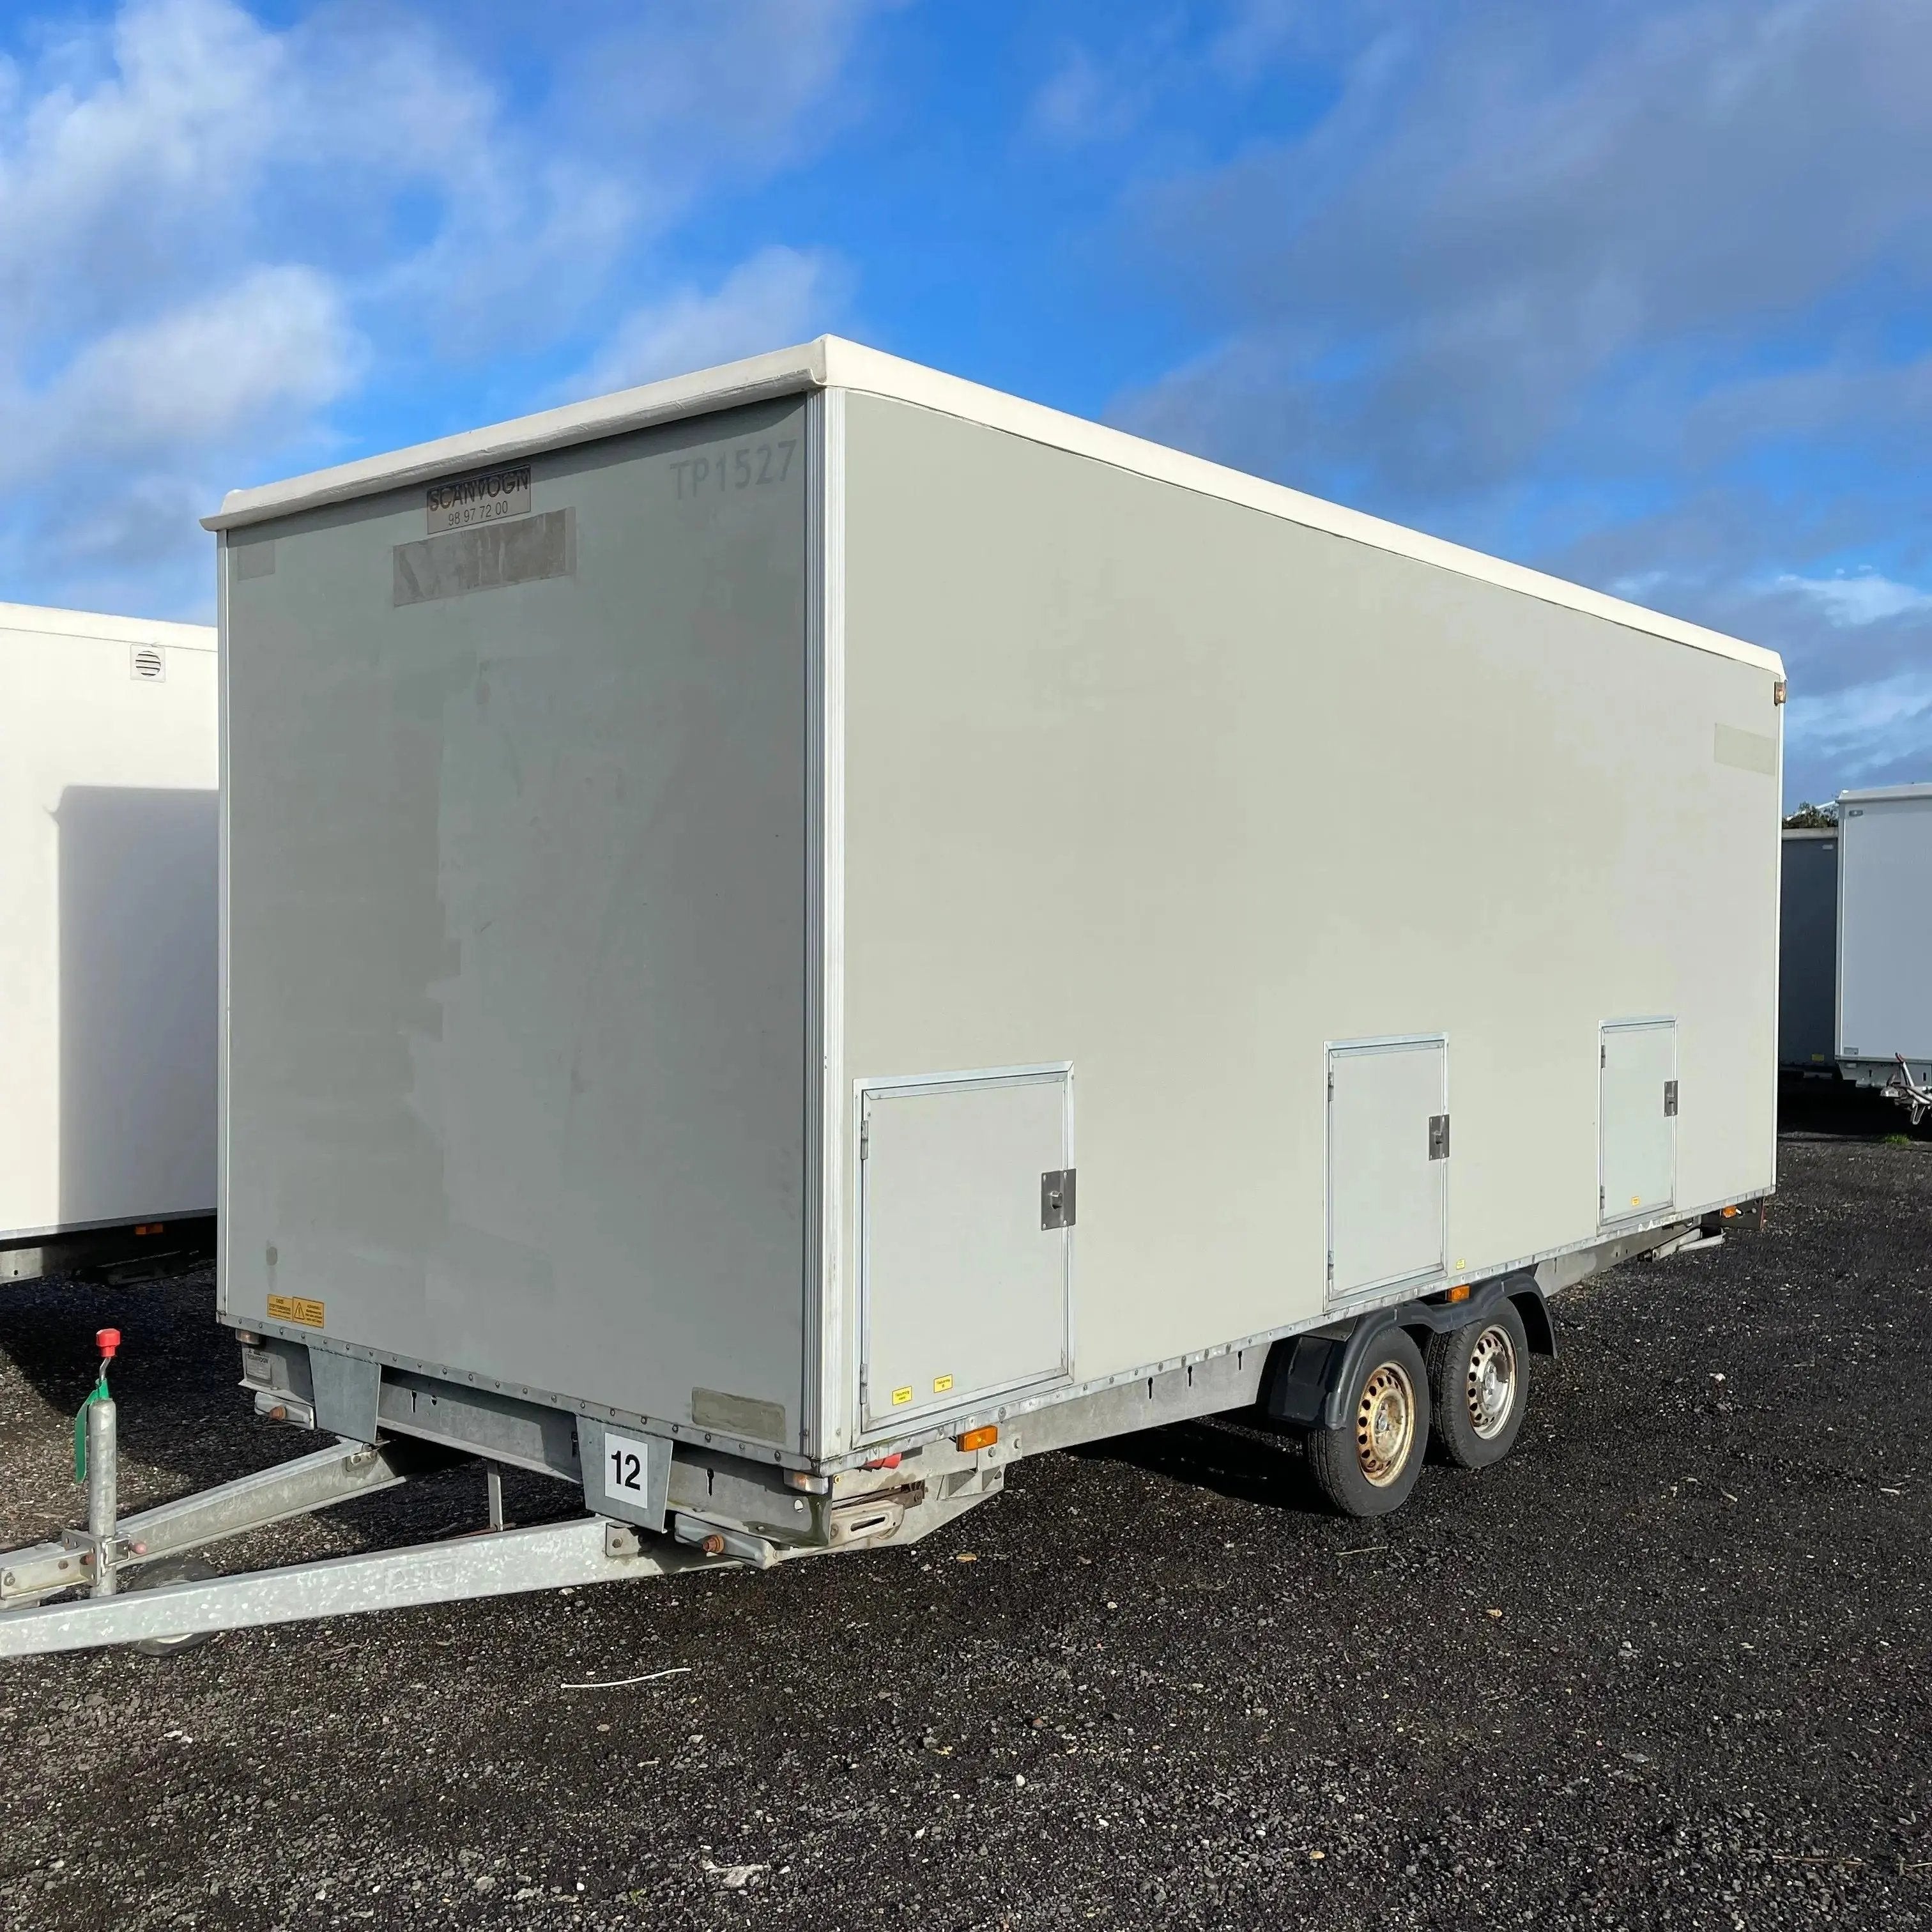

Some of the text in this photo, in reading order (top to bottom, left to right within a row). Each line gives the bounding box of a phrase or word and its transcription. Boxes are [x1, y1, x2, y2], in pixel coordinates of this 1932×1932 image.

[429, 468, 529, 512] SCANVOGN
[670, 439, 797, 500] TP1527
[448, 500, 509, 526] 98 97 72 00
[611, 1450, 641, 1491] 12
